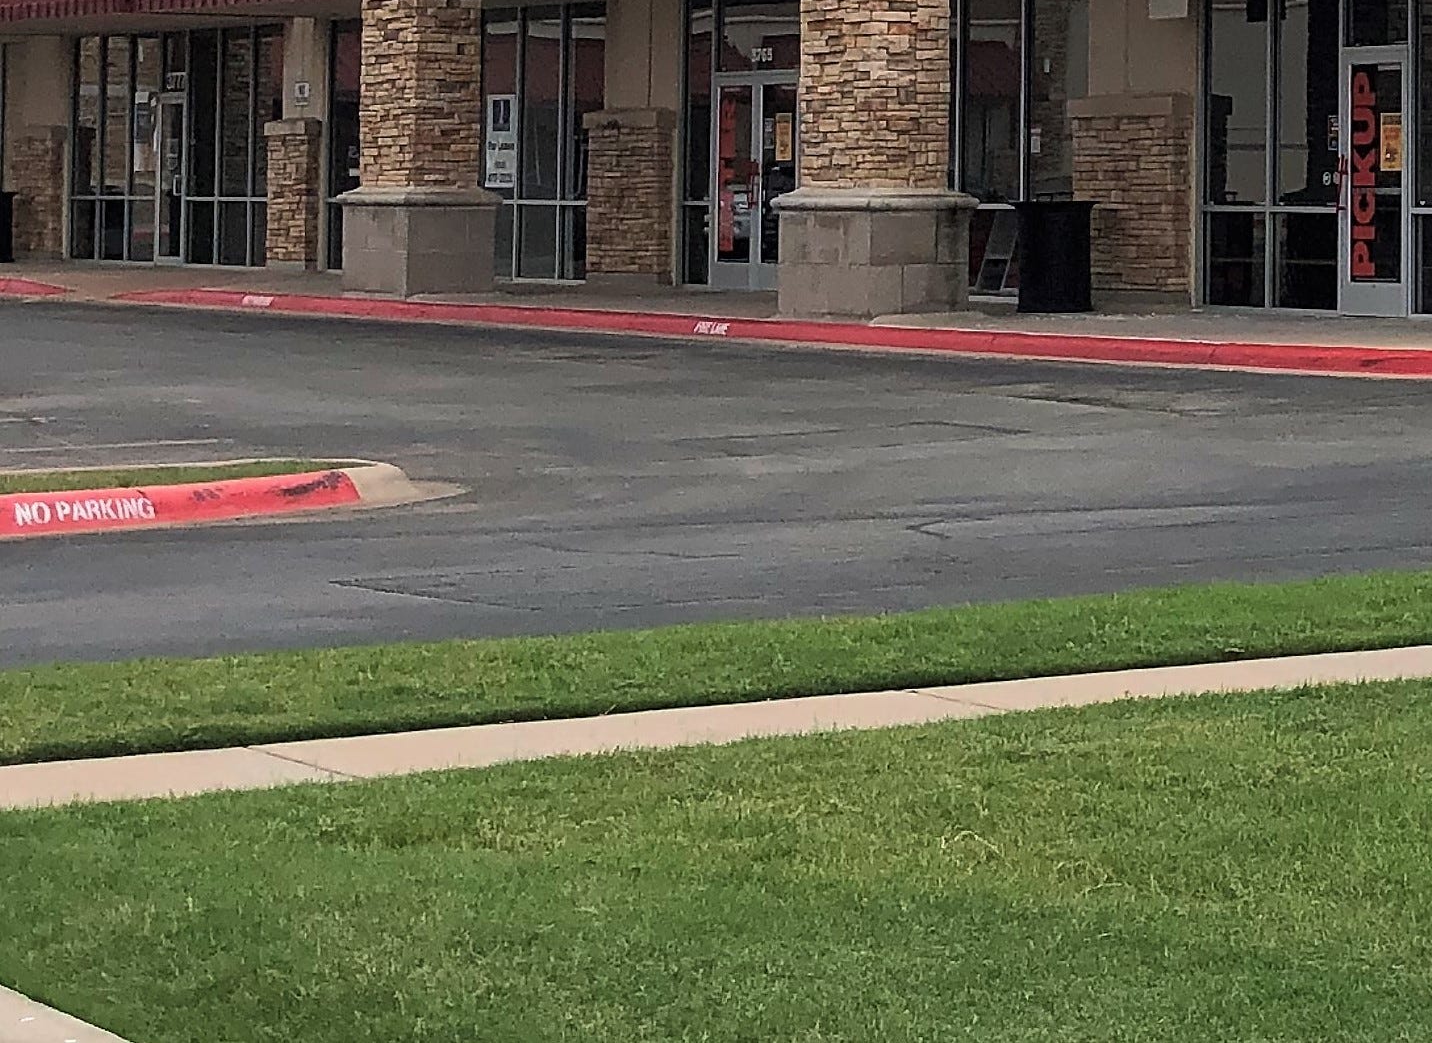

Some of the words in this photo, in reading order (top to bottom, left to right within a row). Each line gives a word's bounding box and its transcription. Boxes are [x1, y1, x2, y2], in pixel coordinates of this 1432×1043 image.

[1352, 71, 1377, 277] PICKUP
[14, 501, 51, 527] NO
[55, 497, 156, 523] PARKING
